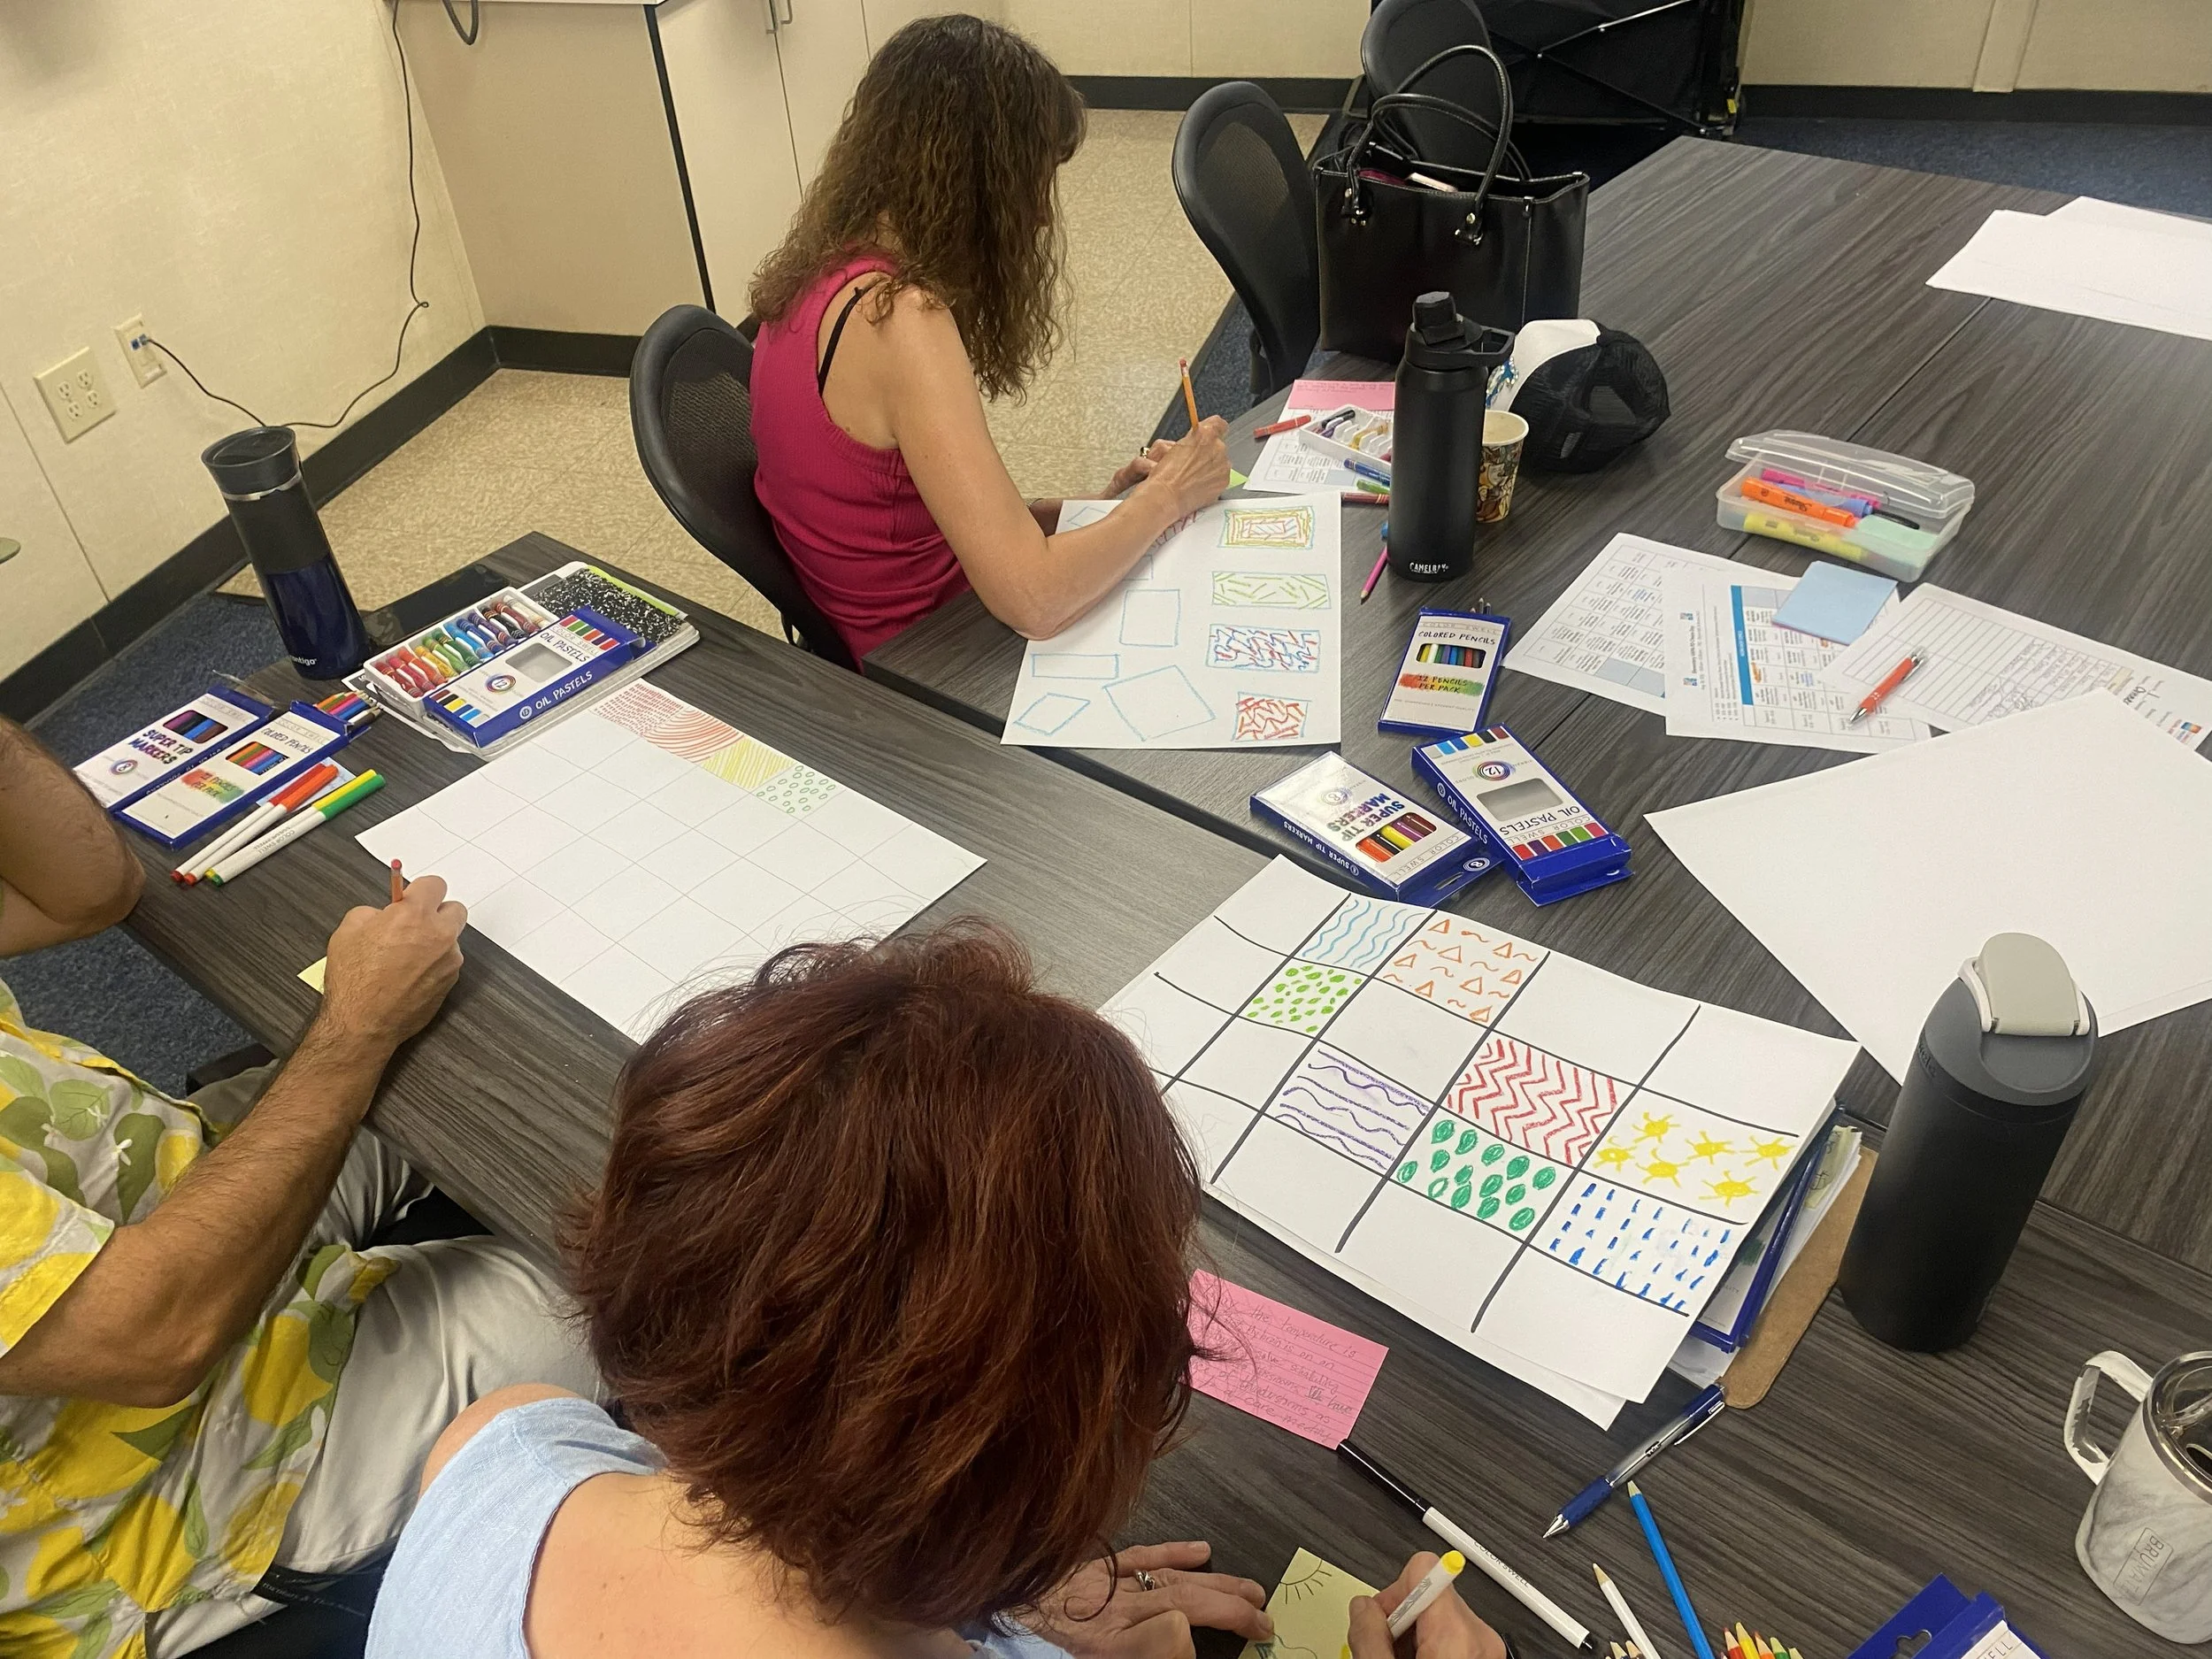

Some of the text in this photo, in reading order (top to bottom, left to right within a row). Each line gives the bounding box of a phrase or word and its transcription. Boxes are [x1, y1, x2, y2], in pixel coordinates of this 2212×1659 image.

[540, 632, 590, 663] OIL PASTELS
[552, 626, 599, 656] COLOR SWELL
[1459, 634, 1495, 645] PENCILS
[494, 680, 507, 688] 12
[535, 696, 551, 709] OIL
[552, 671, 593, 700] PASTELS
[1432, 675, 1468, 687] PENCILS
[1438, 685, 1461, 694] PACK
[128, 738, 177, 764] MARKERS
[142, 728, 194, 756] SUPER TIP
[1485, 766, 1501, 775] 12
[1326, 793, 1391, 832] MARKERS
[1342, 801, 1405, 841] SUPER TIP
[1448, 795, 1457, 811] OIL
[1460, 809, 1488, 844] PASTELS
[1500, 806, 1580, 835] OIL PASTELS
[1284, 821, 1313, 845] MARKERS
[1509, 817, 1590, 843] COLOR SWELL
[1316, 843, 1325, 853] TIP
[1329, 850, 1349, 869] SUPER
[1394, 835, 1459, 876] COLOR SWELL
[1250, 1305, 1270, 1322] the
[1342, 1346, 1356, 1357] is
[1316, 1412, 1330, 1423] as
